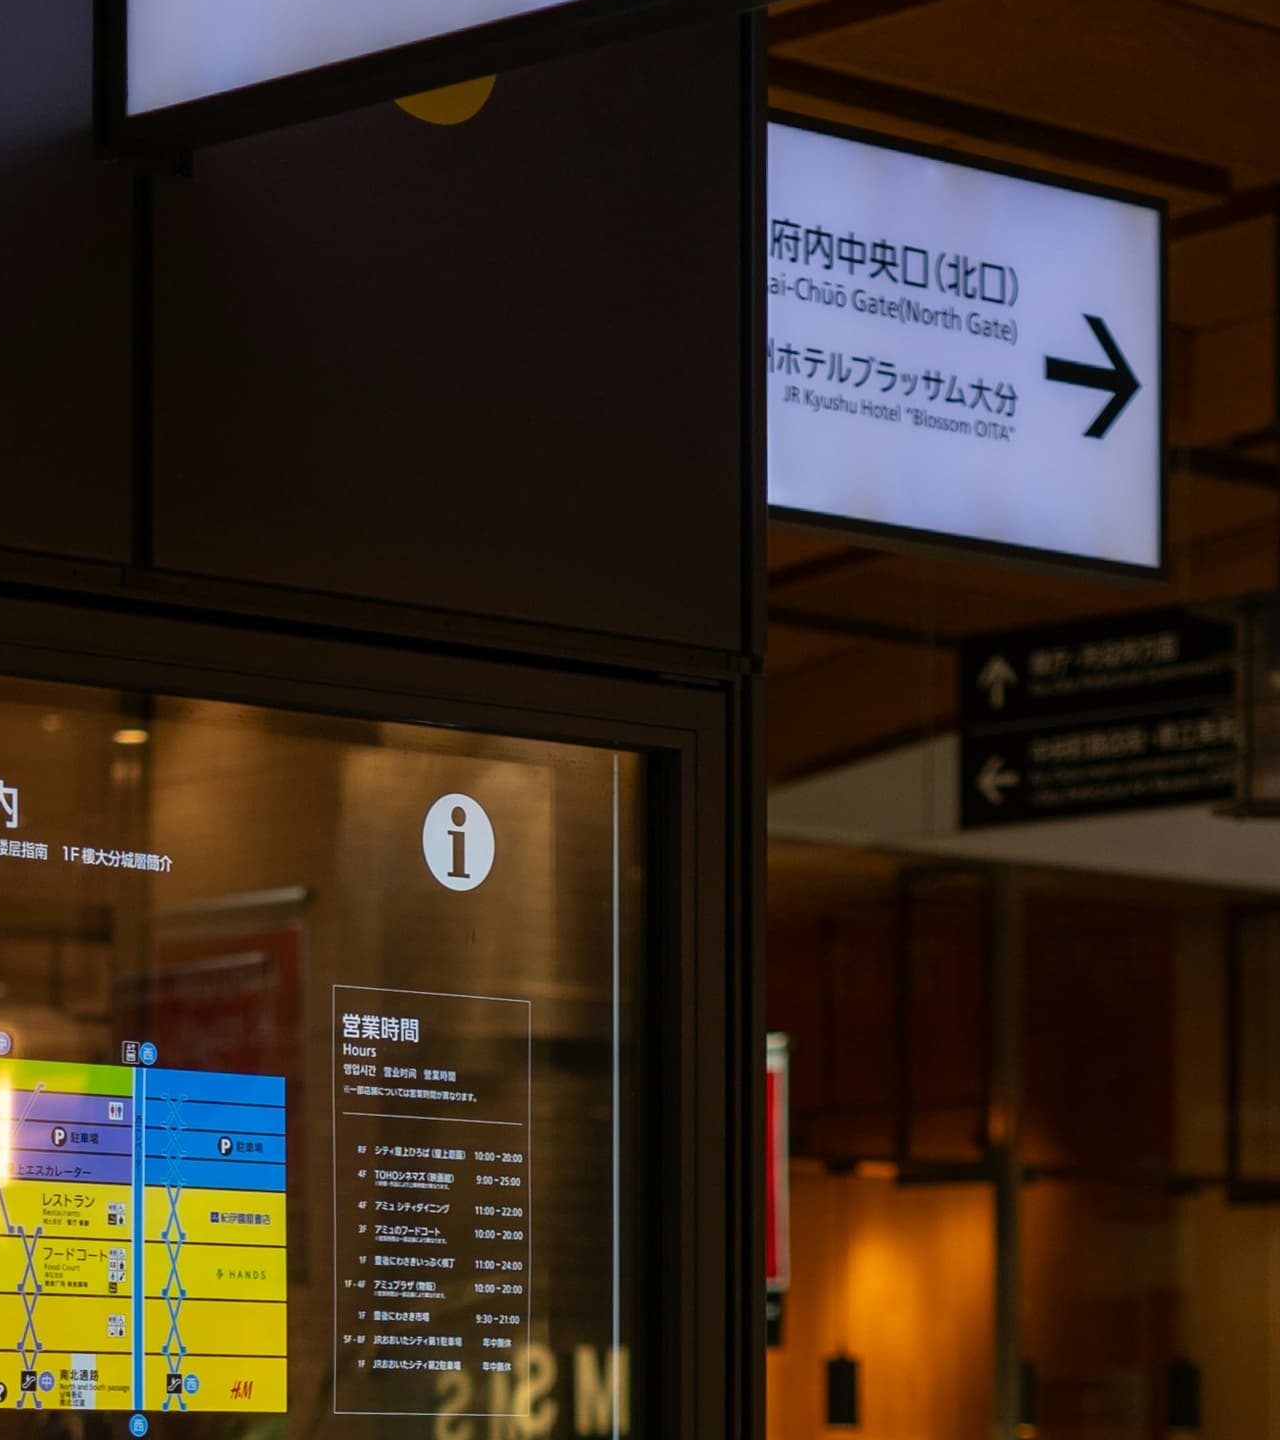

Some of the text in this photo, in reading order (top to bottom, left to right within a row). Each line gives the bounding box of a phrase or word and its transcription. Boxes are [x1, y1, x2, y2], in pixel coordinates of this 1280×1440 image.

[770, 217, 1019, 308] 府内中央口（北口）
[768, 272, 848, 308] ai-Chūō
[966, 312, 1019, 346] Gate)
[803, 387, 858, 416] Kyushu
[860, 398, 902, 422] Hotel
[62, 845, 80, 862] 1F
[342, 1013, 420, 1043] 営業時間
[342, 1044, 377, 1058] Hours
[43, 1192, 96, 1209] レストラン
[43, 1246, 108, 1262] フードコート
[229, 1270, 267, 1281] HANDS
